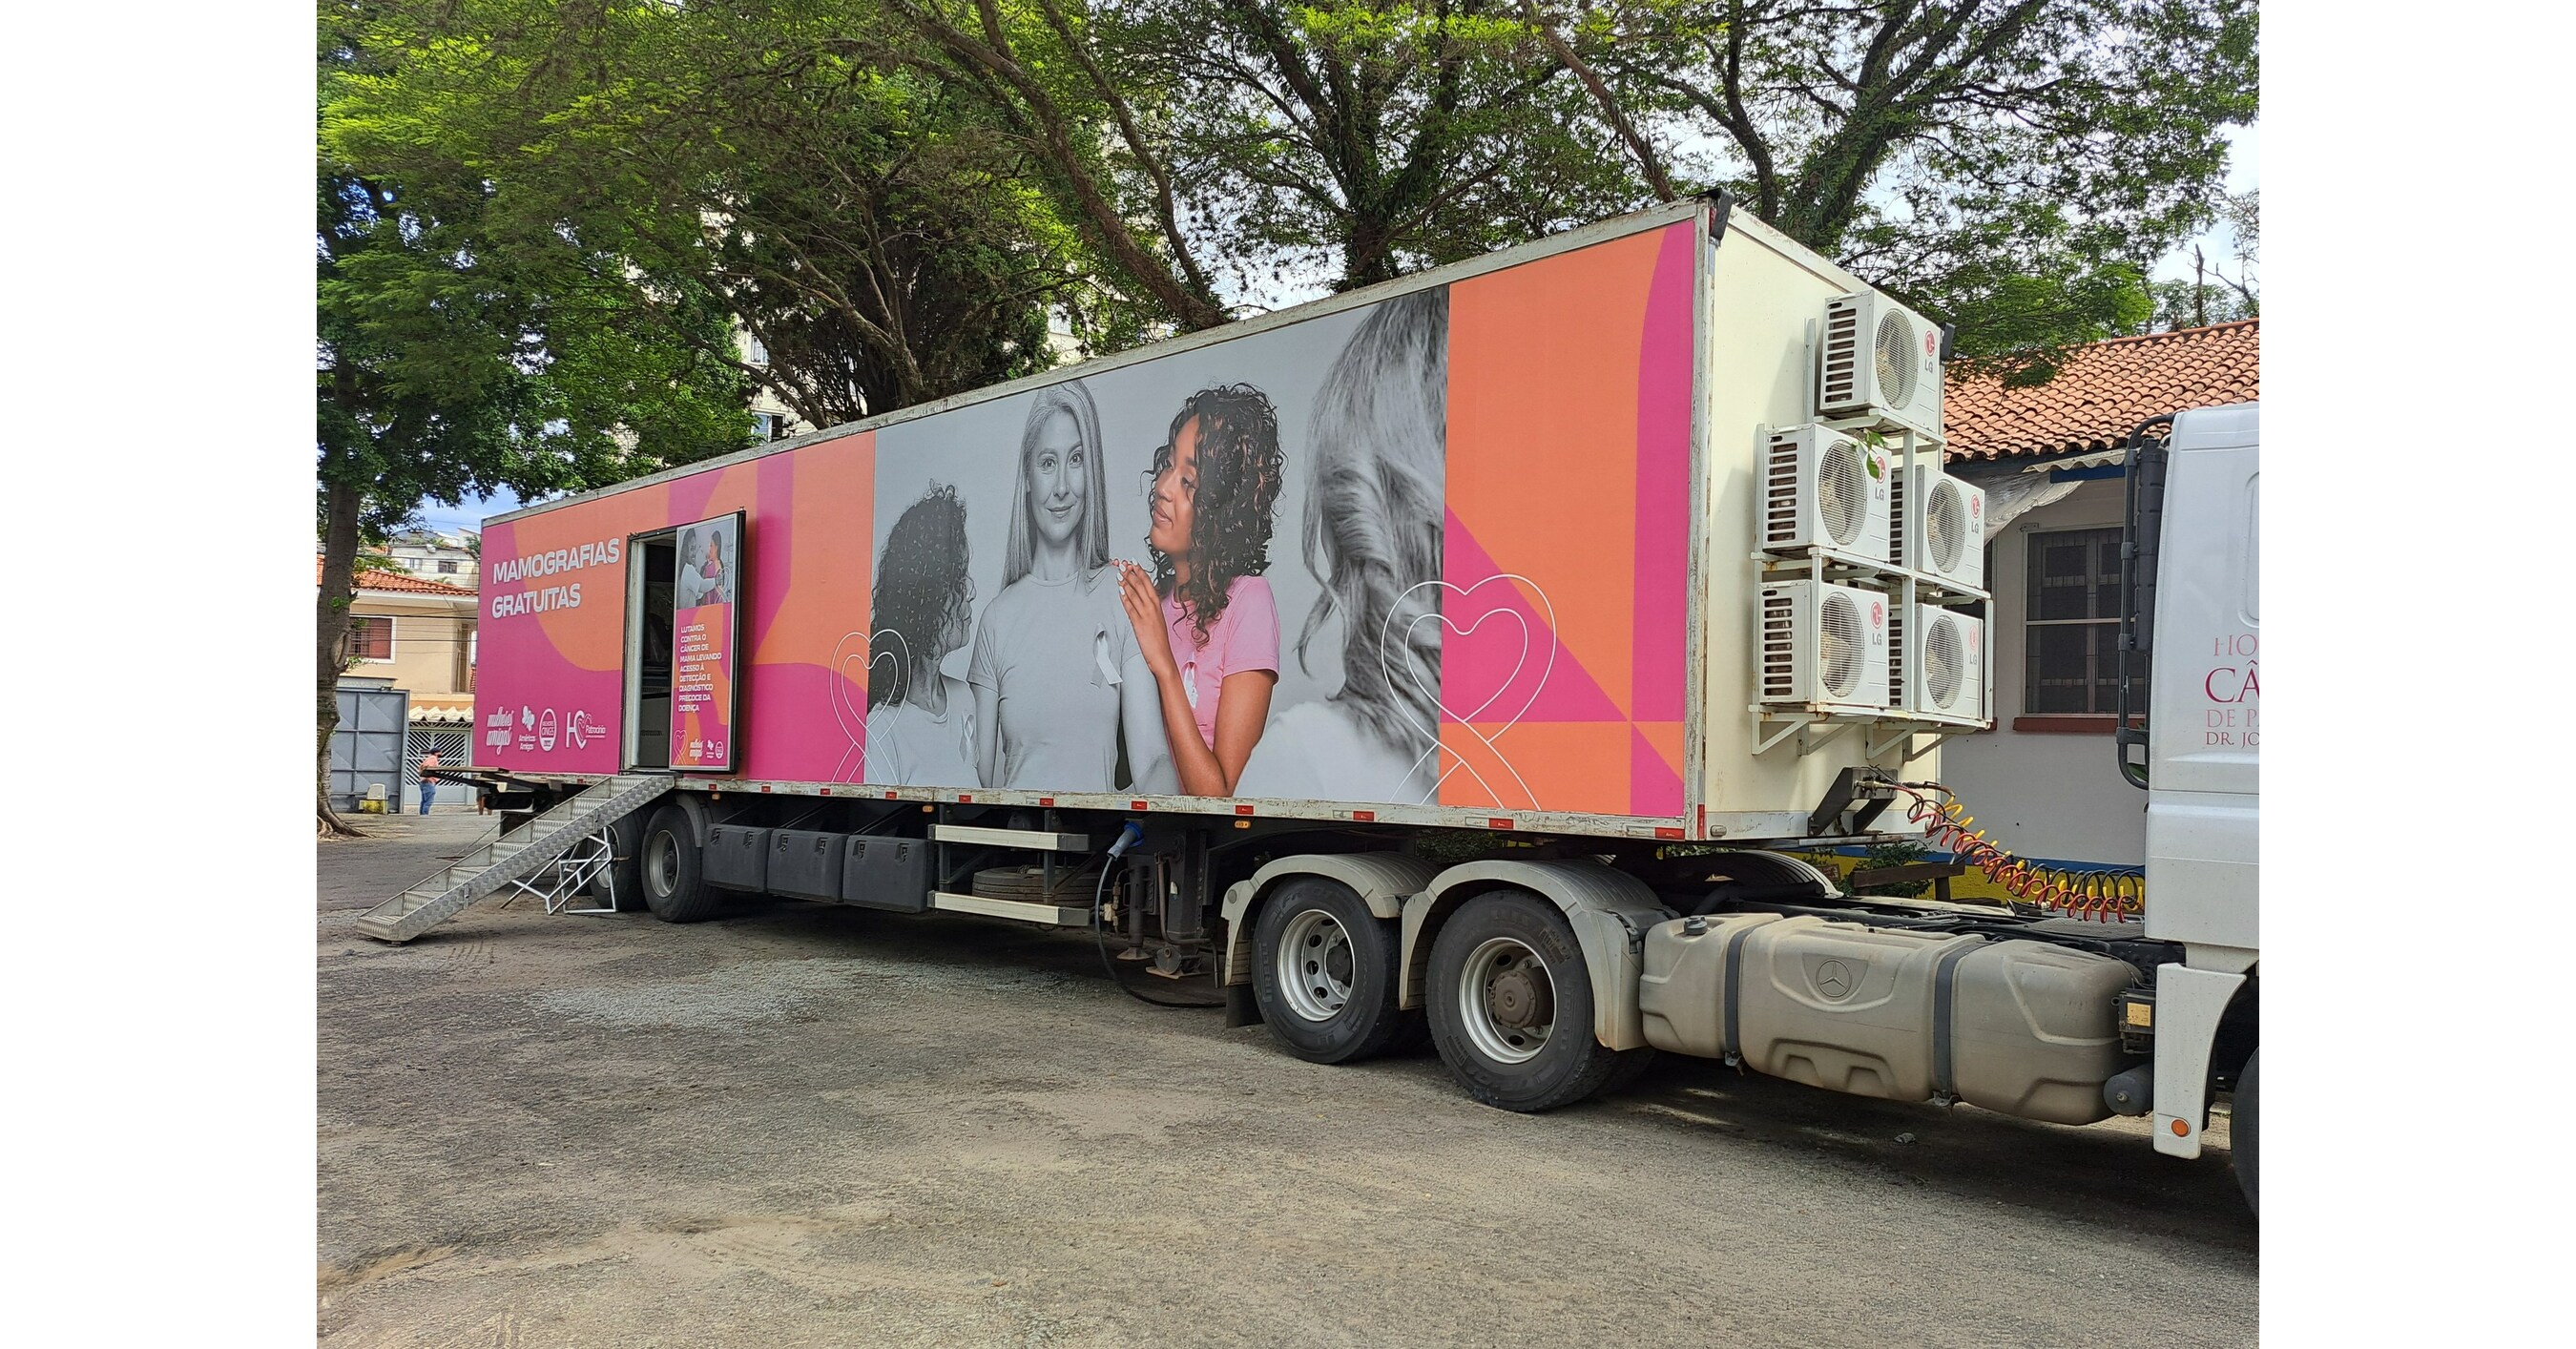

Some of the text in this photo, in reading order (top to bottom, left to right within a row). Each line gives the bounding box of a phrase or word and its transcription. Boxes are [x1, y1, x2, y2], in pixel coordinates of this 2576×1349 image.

[1924, 359, 1934, 374] LG
[1875, 487, 1884, 501] LG
[1971, 521, 1979, 534] LG
[492, 537, 620, 584] MAMOGRAFIAS
[491, 583, 581, 618] GRATUITAS
[680, 624, 705, 633] LUTAMOS
[680, 634, 701, 643] CONTRA
[1872, 633, 1882, 646] LG
[679, 653, 722, 663] MAMA LEVANDO
[1969, 654, 1978, 666] LG
[679, 664, 699, 673] ACESSO
[677, 704, 700, 713] DOENÇA
[2206, 708, 2259, 728] DE P
[2206, 731, 2234, 746] DR.
